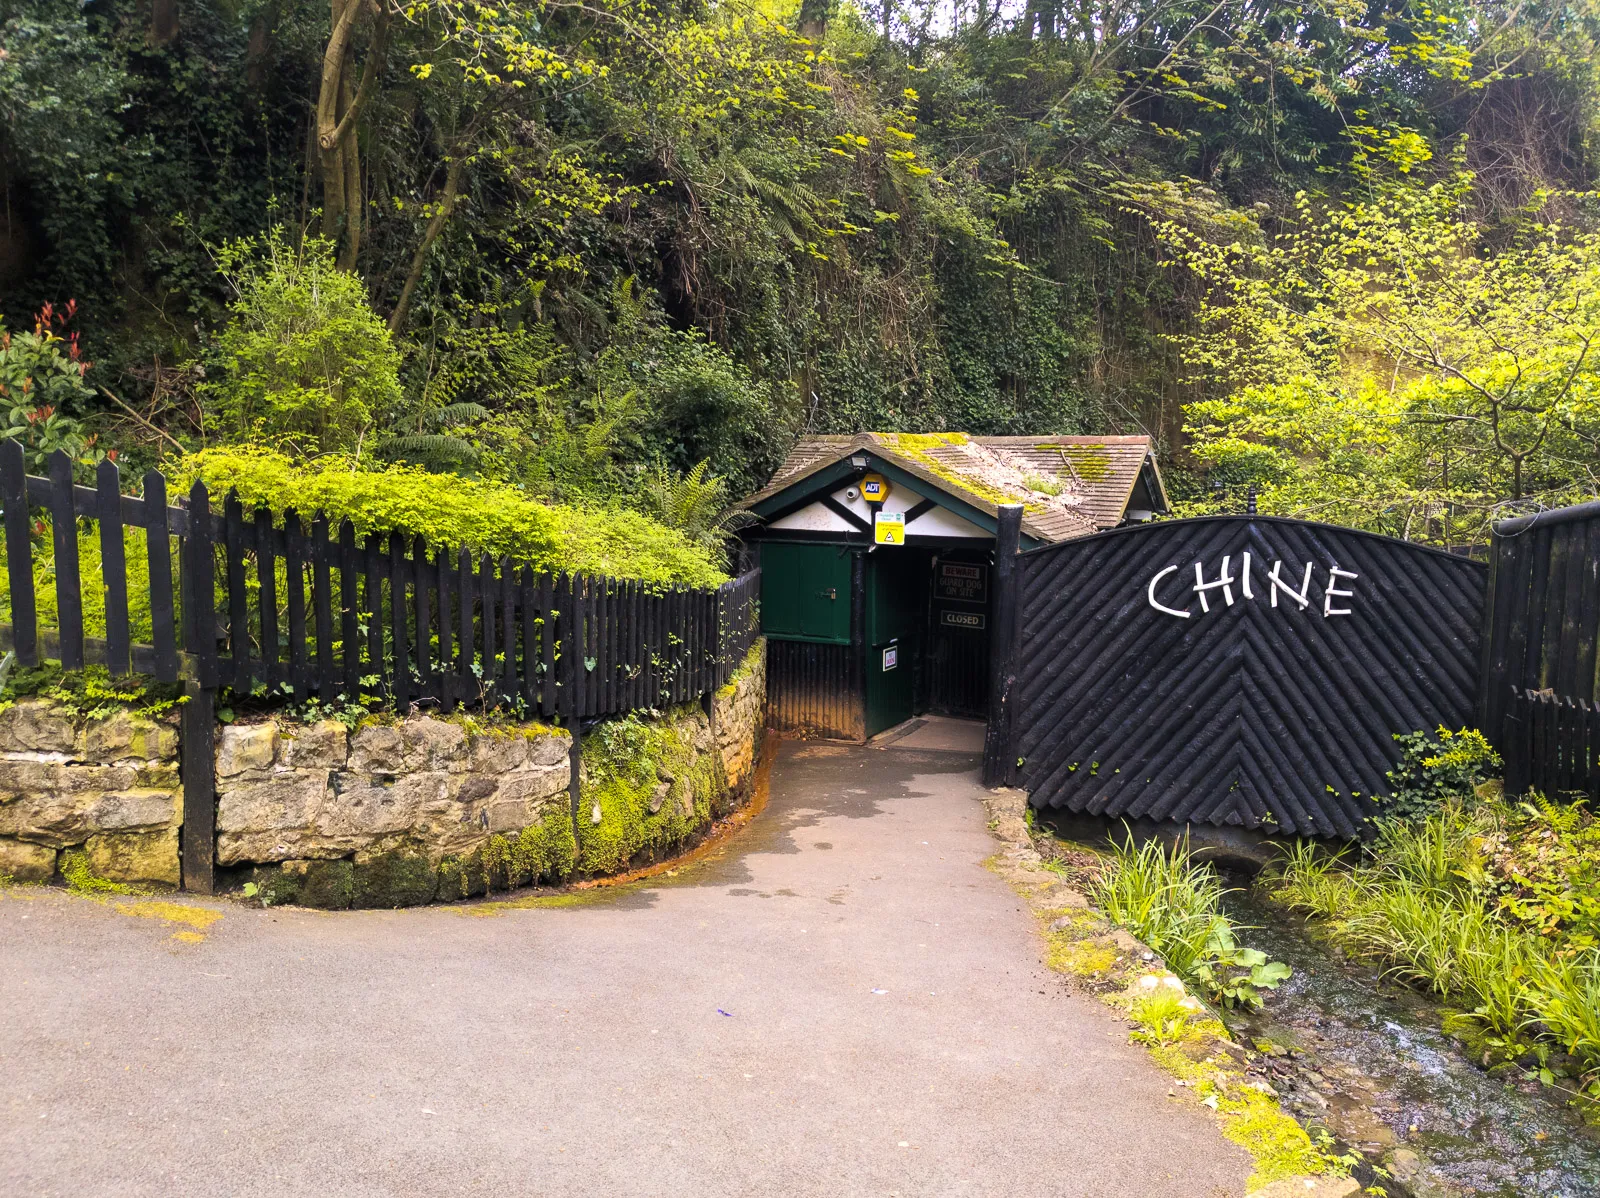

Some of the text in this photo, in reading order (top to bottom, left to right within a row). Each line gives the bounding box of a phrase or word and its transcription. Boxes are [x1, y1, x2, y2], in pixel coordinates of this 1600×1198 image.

[865, 483, 880, 492] ADT
[945, 567, 977, 577] BEWARE
[939, 578, 982, 590] GUARD DOG
[1148, 551, 1359, 619] CHINE
[946, 586, 974, 598] ON SITE
[946, 613, 979, 625] CLOSED
